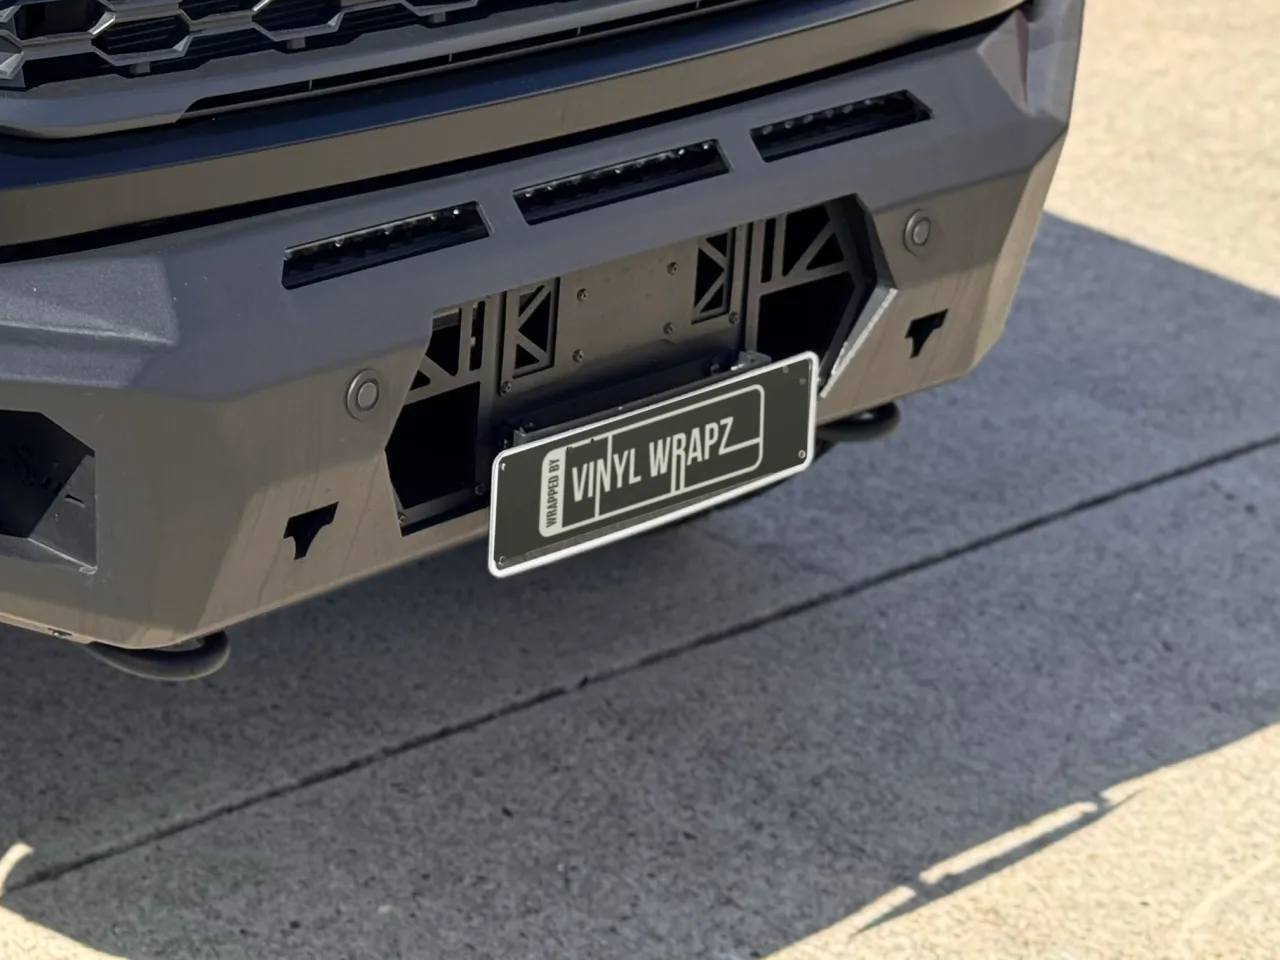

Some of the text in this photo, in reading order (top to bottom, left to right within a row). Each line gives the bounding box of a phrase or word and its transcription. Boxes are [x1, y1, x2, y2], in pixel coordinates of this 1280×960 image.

[546, 458, 561, 529] WRAPPED BY
[571, 416, 735, 509] VINYL WRAPZ
